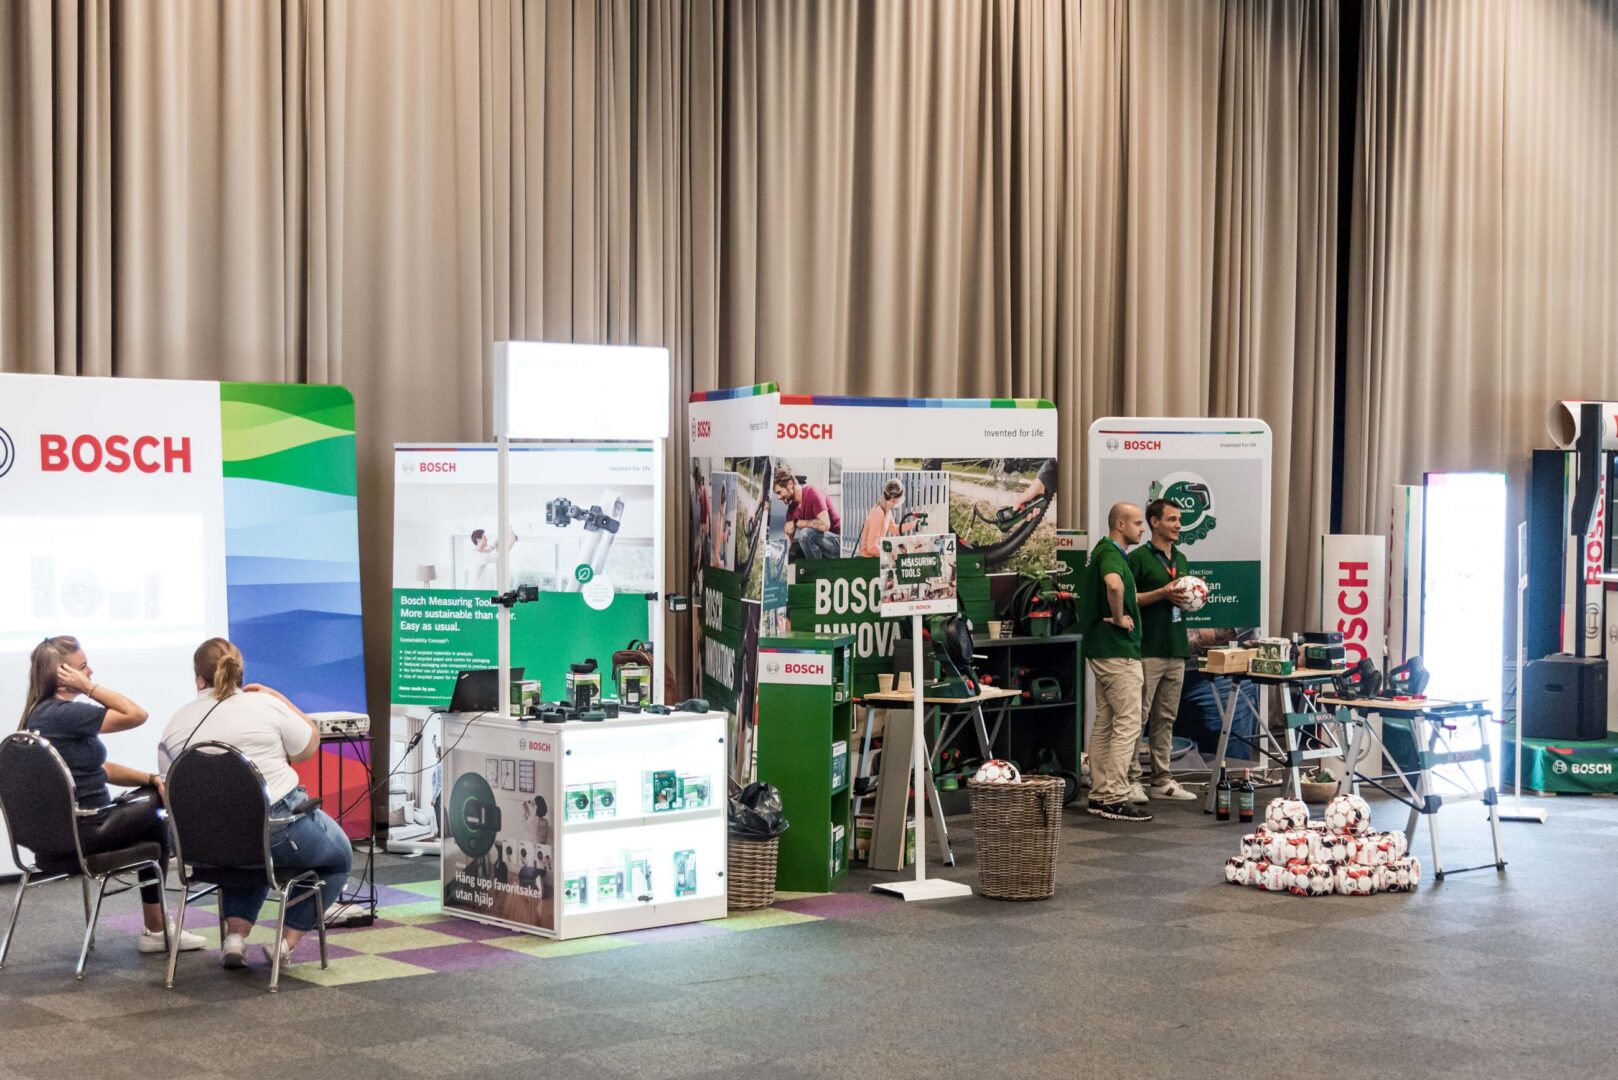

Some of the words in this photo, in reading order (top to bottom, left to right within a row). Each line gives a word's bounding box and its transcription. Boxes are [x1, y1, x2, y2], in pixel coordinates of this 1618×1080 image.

[698, 420, 711, 438] BOSCH
[777, 423, 833, 440] BOSCH
[984, 429, 1017, 438] Invented
[1019, 429, 1029, 438] for
[1031, 429, 1044, 438] life
[1124, 440, 1161, 450] BOSCH
[40, 434, 192, 474] BOSCH
[419, 462, 456, 473] BOSCH
[946, 541, 955, 553] 4
[901, 557, 937, 568] MEASURING
[901, 568, 921, 578] TOOLS
[1058, 582, 1075, 591] tery
[815, 577, 881, 615] BOSC
[1207, 594, 1239, 603] driver.
[400, 596, 426, 606] Bosch
[429, 597, 472, 608] Measuring
[401, 609, 422, 618] More
[425, 610, 472, 620] sustainable
[475, 611, 493, 620] than
[1337, 561, 1368, 676] OSCH
[400, 621, 420, 632] Easy
[422, 623, 432, 631] as
[435, 623, 460, 632] usual.
[784, 663, 824, 674] BOSCH
[528, 741, 551, 752] BOSCH
[1571, 763, 1612, 774] BOSCH
[455, 871, 475, 888] Häng
[476, 877, 492, 890] upp
[455, 889, 472, 901] utan
[474, 892, 494, 907] hjälp
